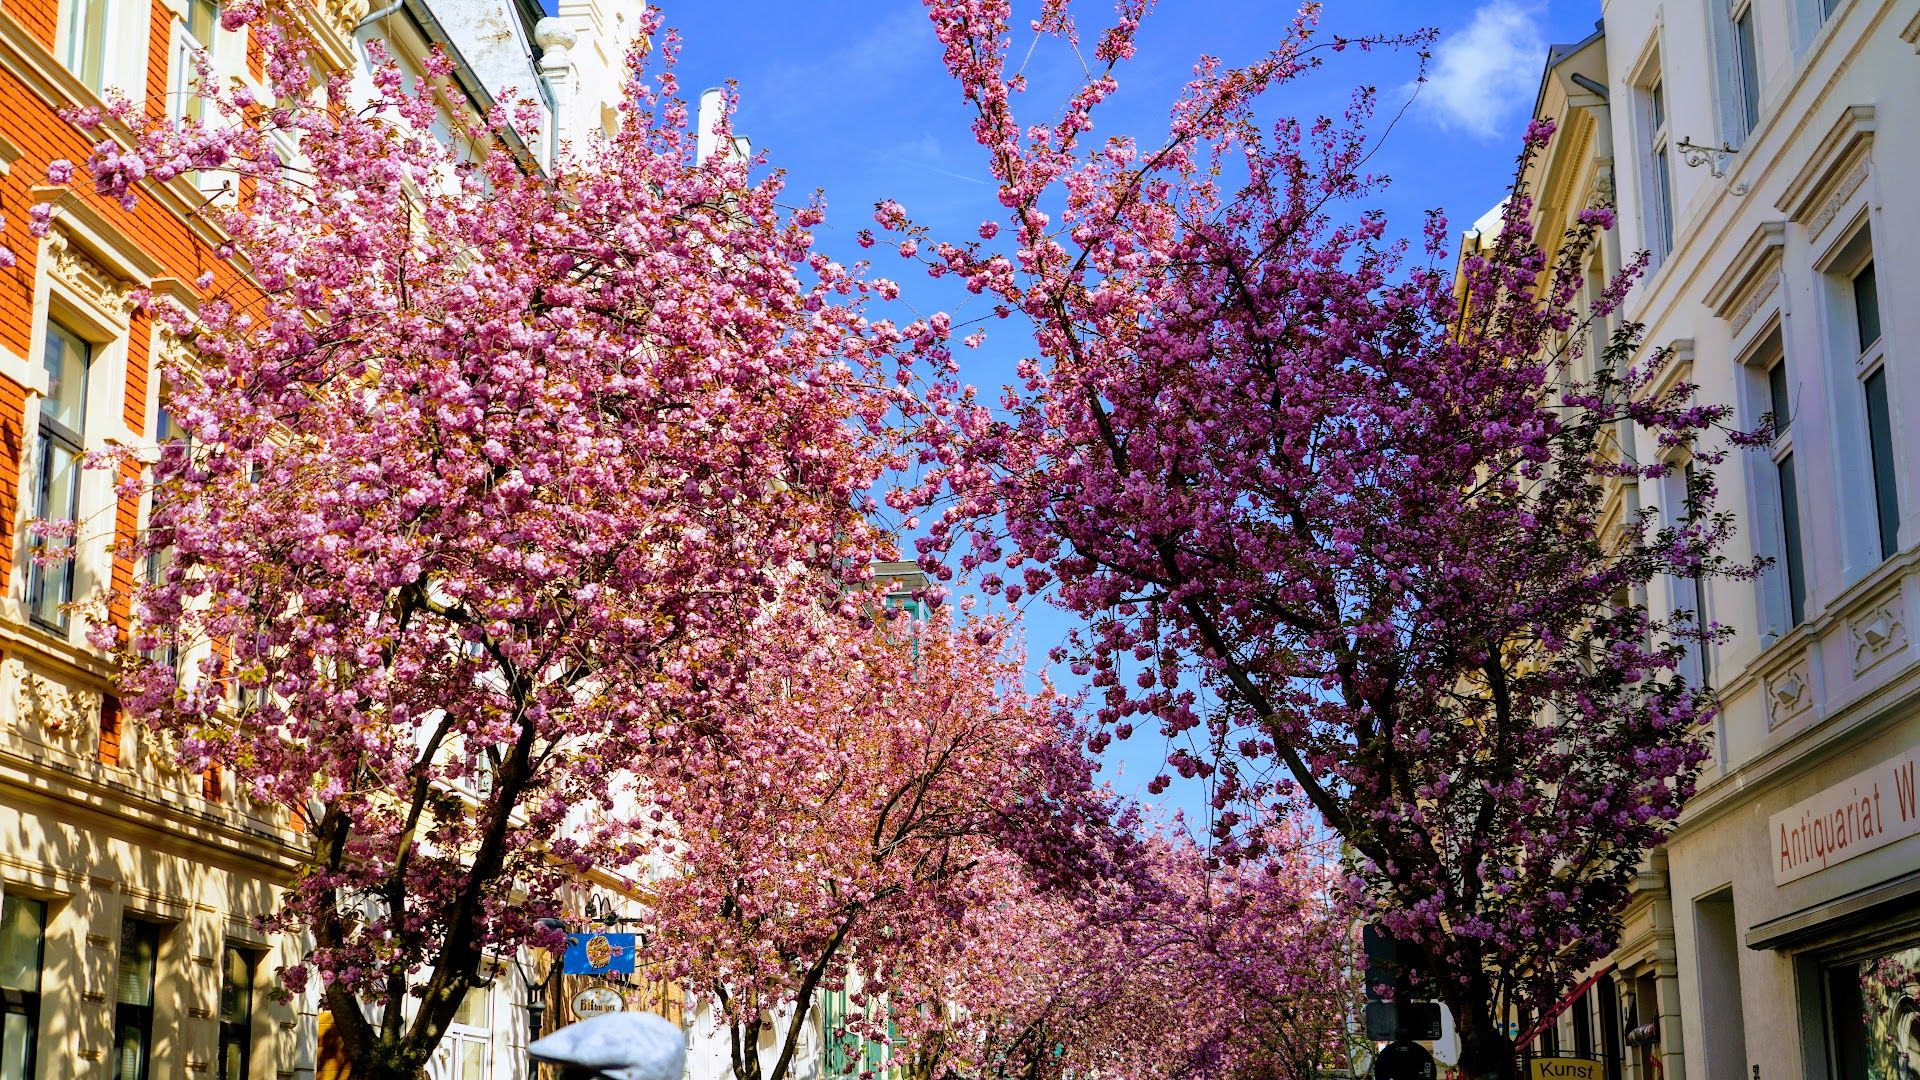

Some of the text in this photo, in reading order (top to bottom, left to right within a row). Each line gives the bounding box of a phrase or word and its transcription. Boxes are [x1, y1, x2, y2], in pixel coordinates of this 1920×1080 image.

[1780, 783, 1883, 872] Antiquariat
[580, 998, 616, 1012] Bitbuger
[1540, 1061, 1594, 1080] Kunst
